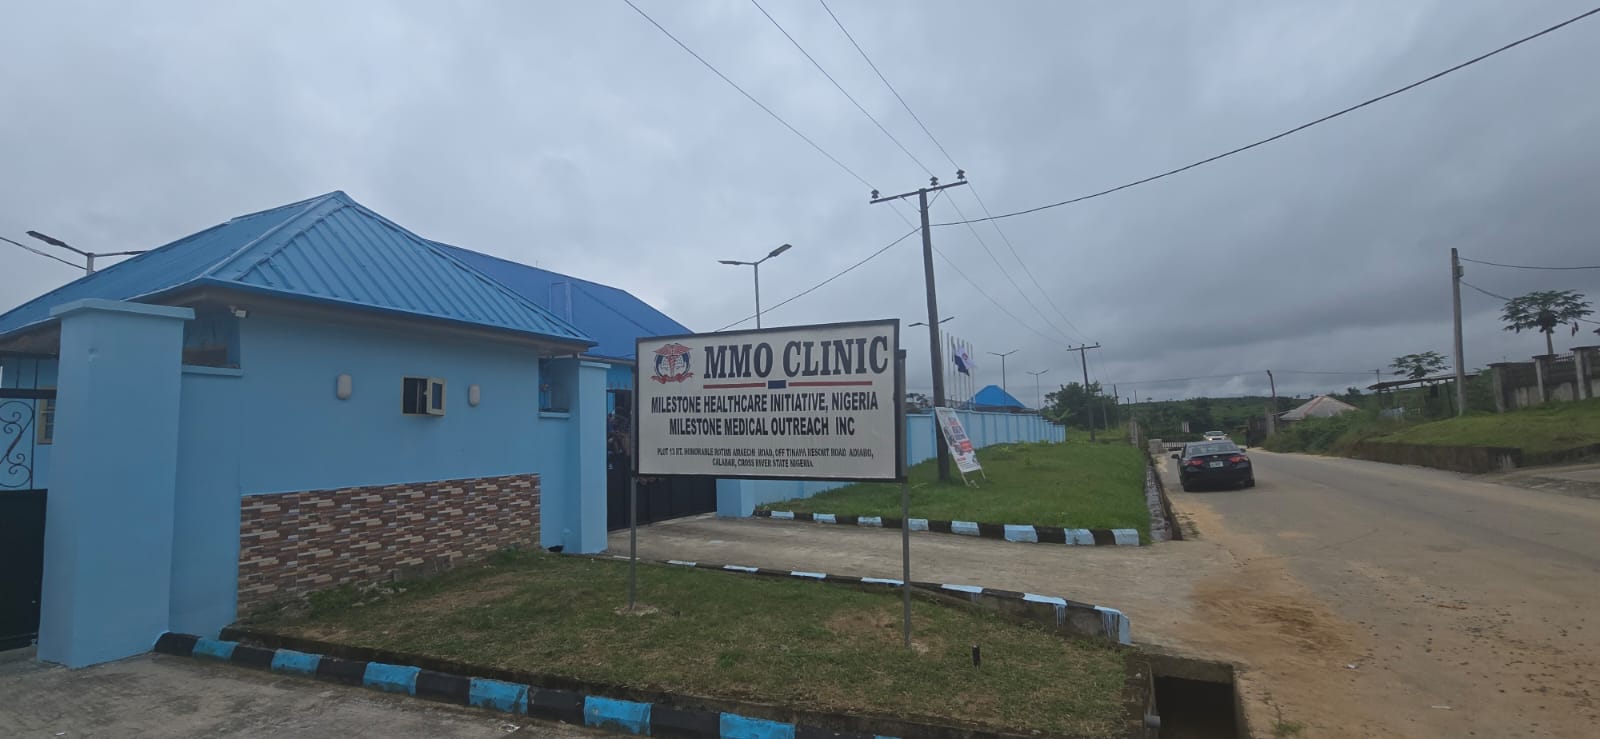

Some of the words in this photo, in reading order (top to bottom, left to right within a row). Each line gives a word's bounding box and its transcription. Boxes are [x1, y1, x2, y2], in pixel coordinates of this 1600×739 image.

[703, 342, 773, 378] MMO
[783, 335, 888, 378] CLINIC
[651, 395, 701, 413] MILESTONE
[704, 394, 767, 413] HEALTHCARE
[770, 392, 829, 413] INITIATIVE,
[832, 391, 878, 410] NIGERIA
[669, 418, 722, 436] MILESTONE
[724, 417, 768, 436] MEDICAL
[771, 416, 829, 436] OUTREACH
[836, 416, 855, 436] INC
[775, 448, 785, 456] OFF
[807, 447, 829, 456] RESORT
[830, 447, 846, 456] ROAD
[738, 458, 754, 467] CROSS
[755, 459, 771, 467] RIVER
[772, 459, 788, 467] STATE
